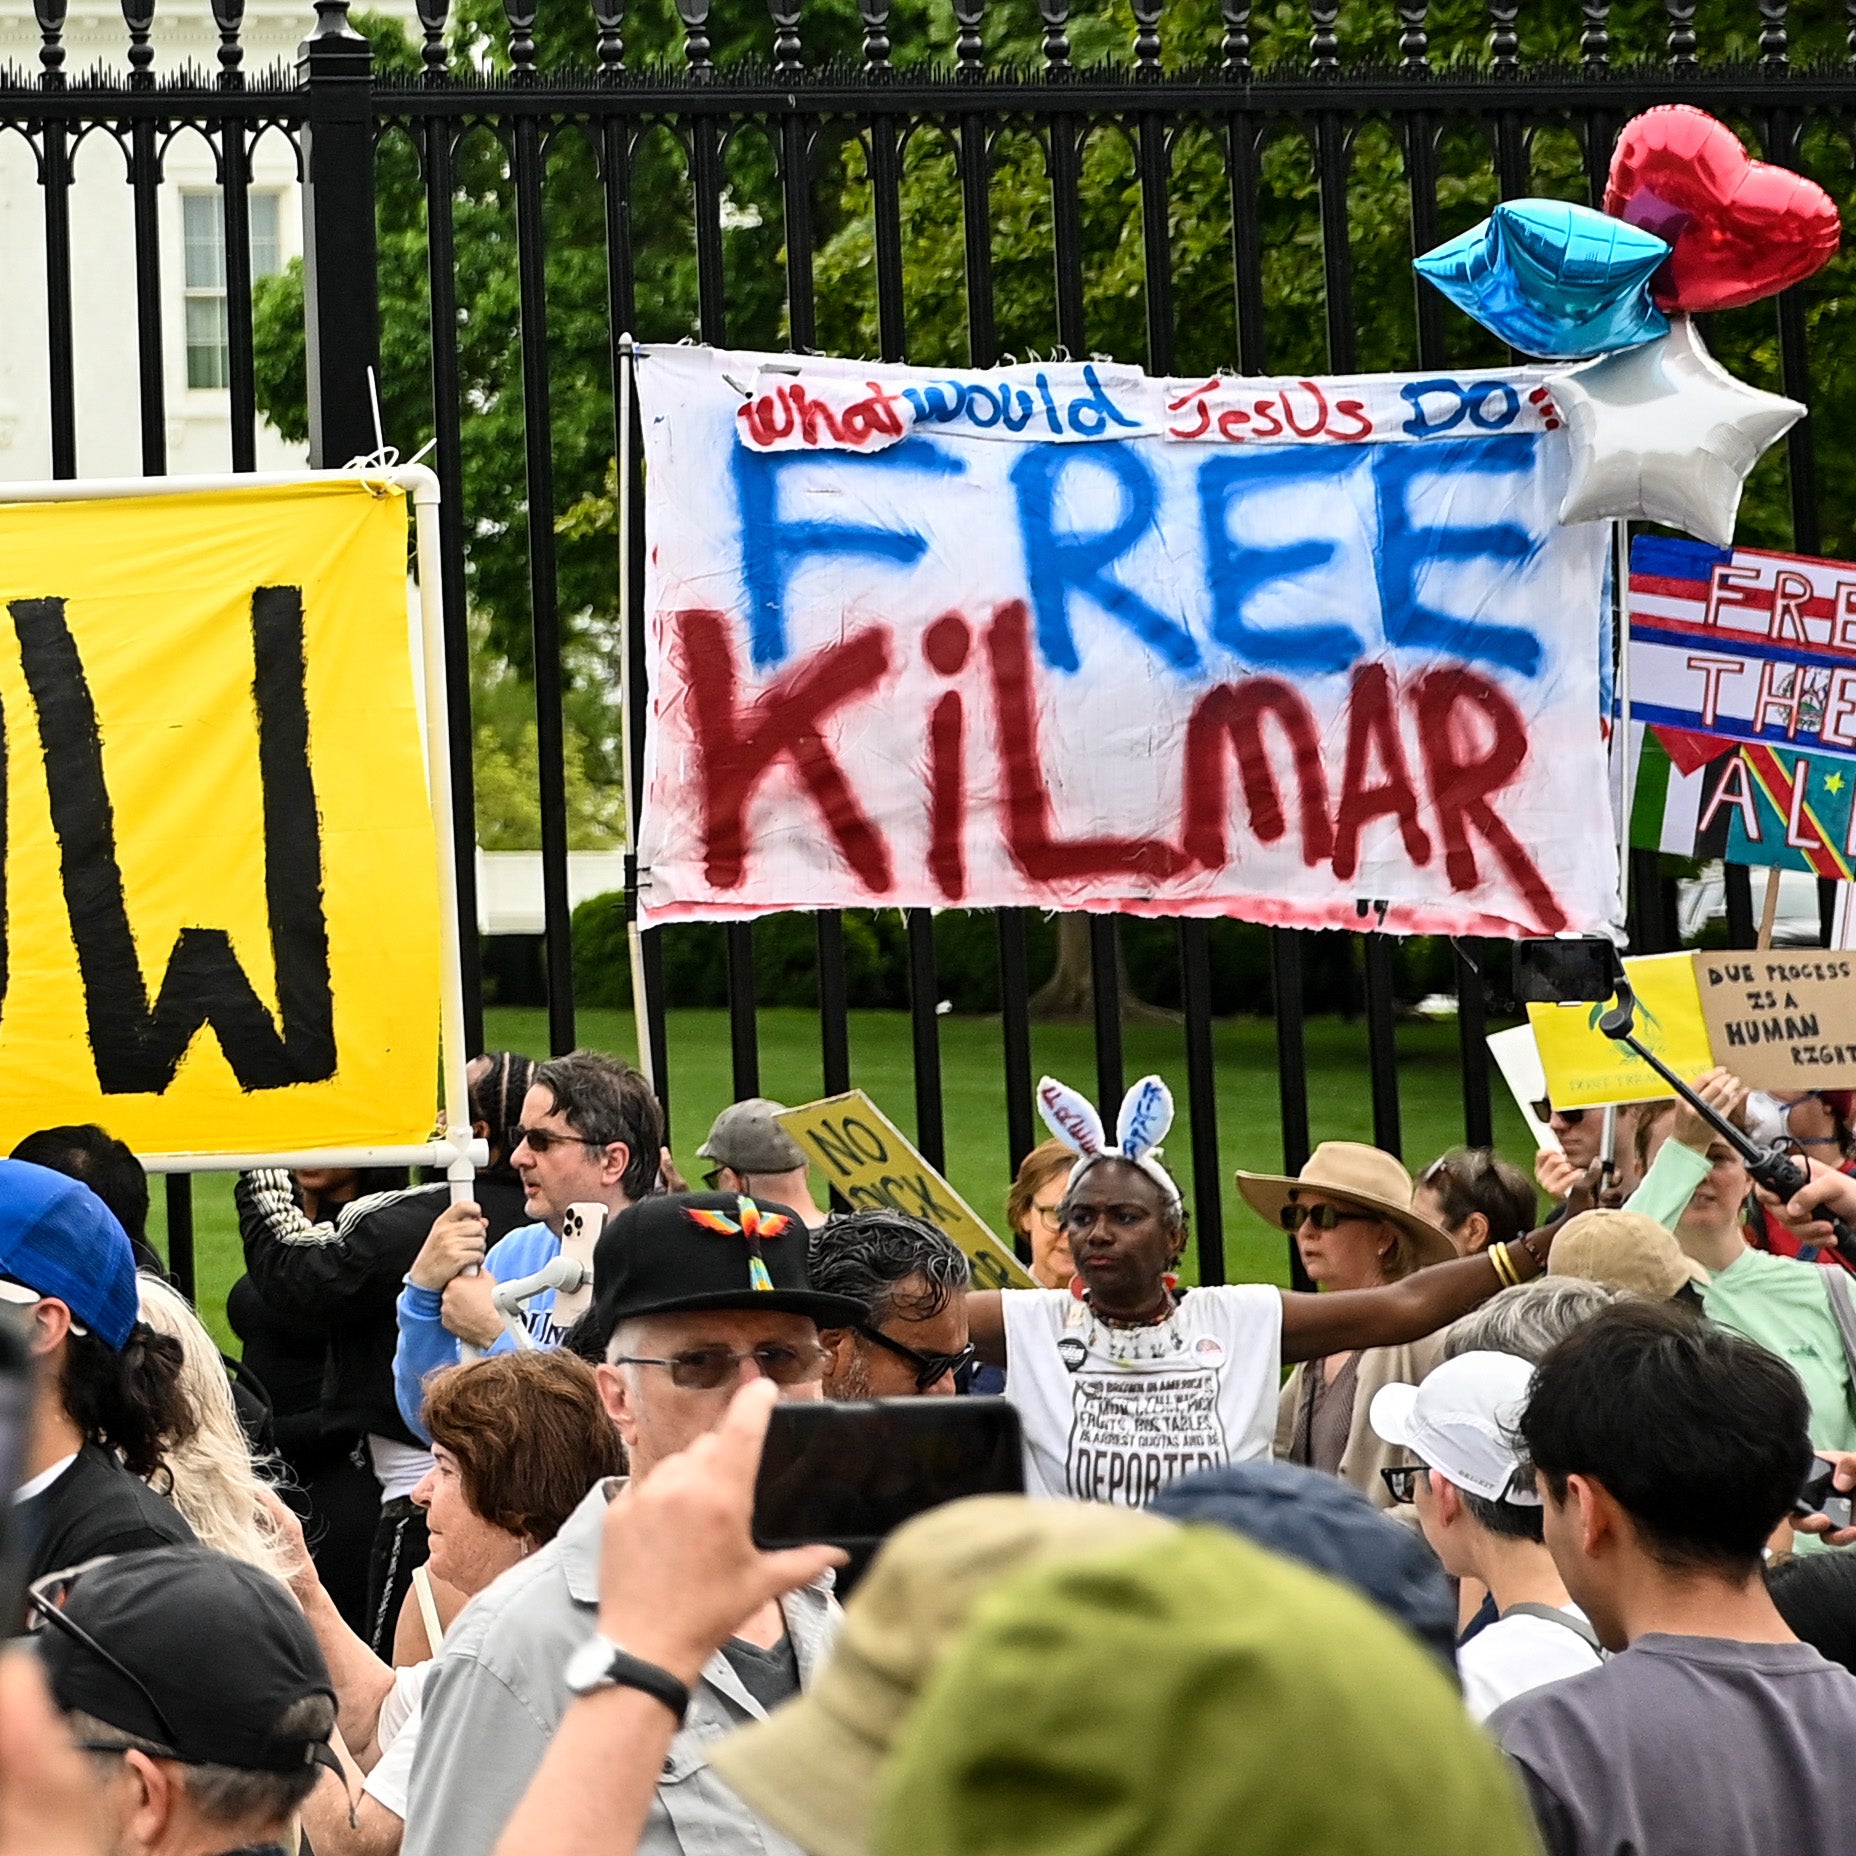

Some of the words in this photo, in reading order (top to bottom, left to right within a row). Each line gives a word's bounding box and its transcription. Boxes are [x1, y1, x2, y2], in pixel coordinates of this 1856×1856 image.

[731, 433, 1544, 675] FREE
[1687, 656, 1856, 748] THE
[1699, 754, 1856, 859] AL
[1708, 963, 1755, 988] DUE
[1765, 960, 1851, 983] PROCESS
[1746, 991, 1778, 1011] IS
[1784, 991, 1800, 1009] A
[1725, 1014, 1820, 1047] HUMAN
[806, 1116, 888, 1176] NO
